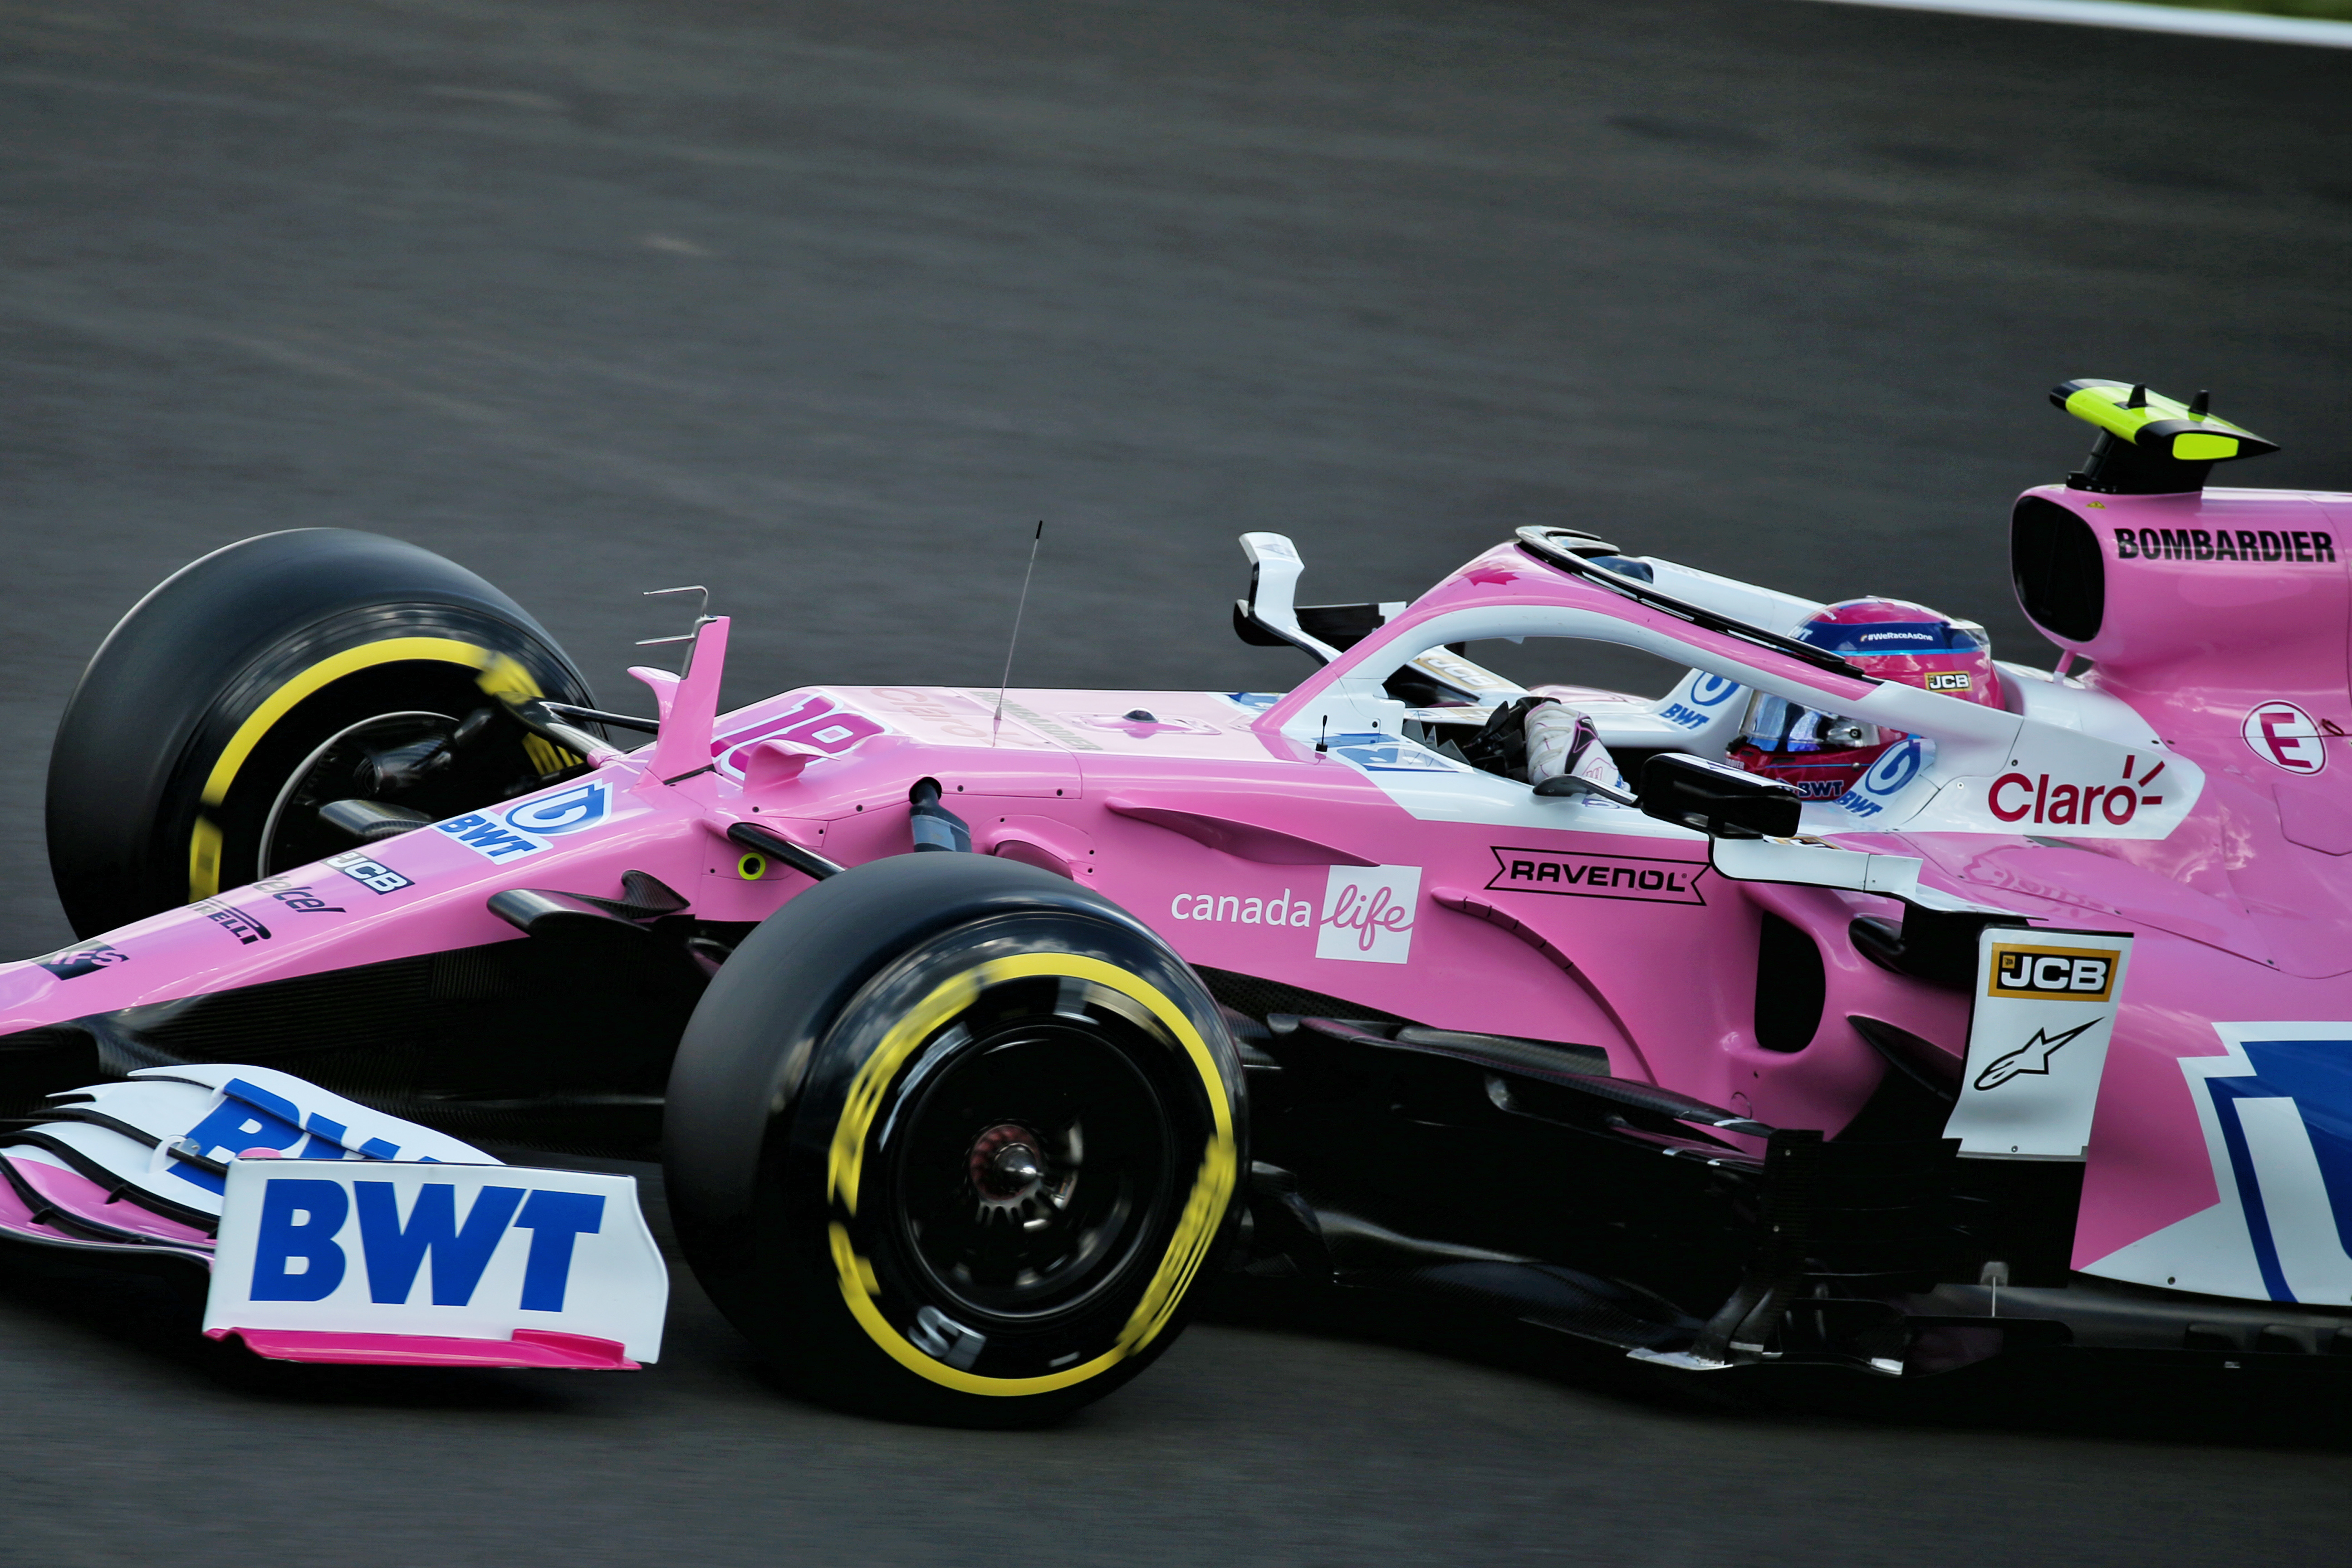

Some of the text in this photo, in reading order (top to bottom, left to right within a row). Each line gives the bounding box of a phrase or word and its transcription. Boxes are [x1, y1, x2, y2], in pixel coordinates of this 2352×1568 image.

[2114, 528, 2335, 562] BOMBARDIER
[1867, 632, 1934, 641] #WeRaceAsOne
[1427, 659, 1499, 686] JCB
[1930, 674, 1970, 689] JCB
[870, 688, 987, 737] Claro
[969, 691, 1103, 750] BOMBARDIER
[1660, 703, 1710, 730] BWT
[1798, 780, 1843, 797] BWT
[1834, 790, 1883, 818] BWT
[1988, 771, 2137, 825] Claro
[436, 813, 537, 857] BWT
[326, 856, 407, 892] JCB
[1171, 884, 1414, 951] canada life
[50, 950, 124, 966] IFS
[2001, 956, 2108, 991] JCB
[249, 1179, 606, 1313] BWT
